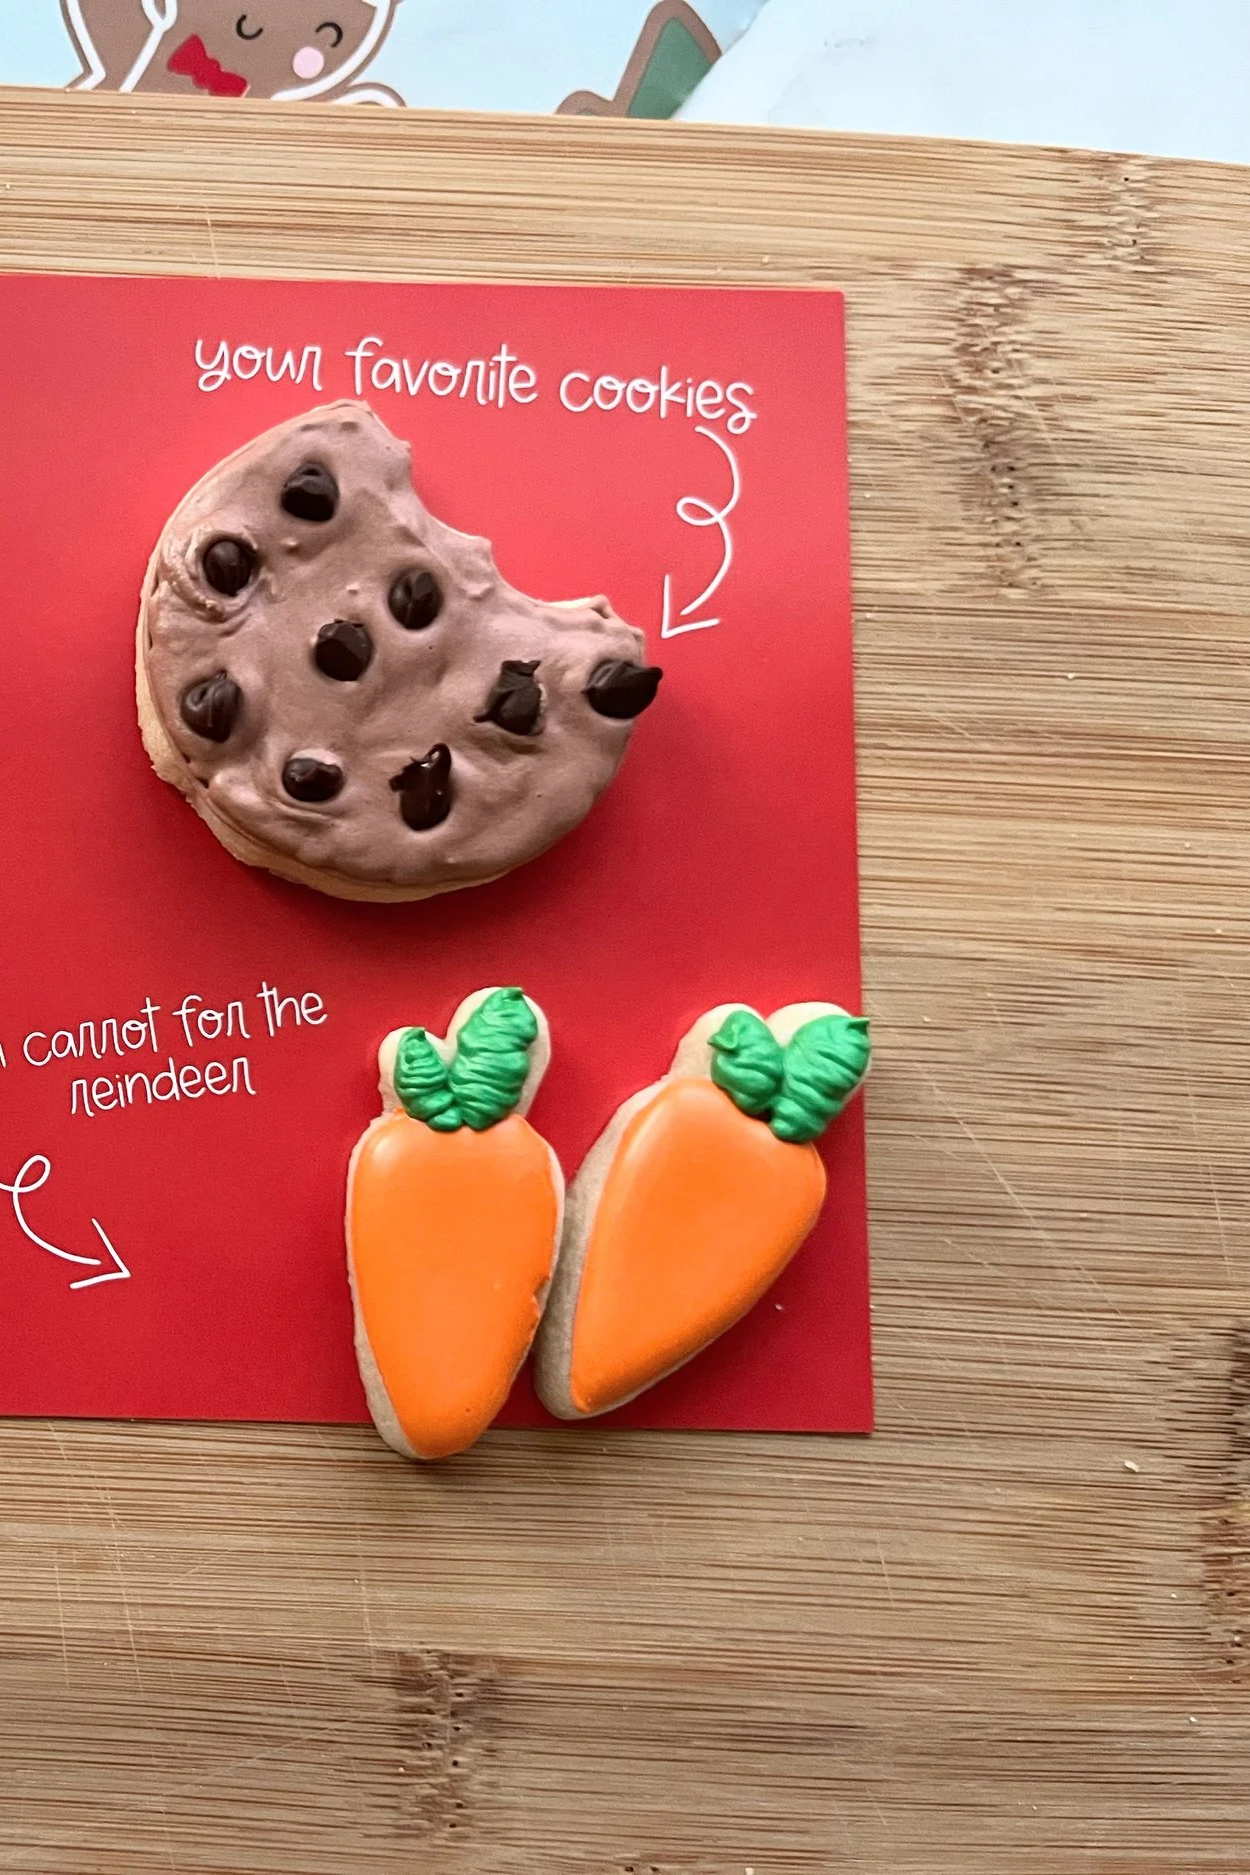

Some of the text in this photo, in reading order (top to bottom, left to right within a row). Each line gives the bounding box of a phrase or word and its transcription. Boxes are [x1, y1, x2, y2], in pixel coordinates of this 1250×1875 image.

[194, 336, 759, 435] your favorite cookies
[23, 996, 161, 1067] carrot
[172, 994, 251, 1047] for
[256, 981, 328, 1037] the
[71, 1056, 257, 1117] reindeer
